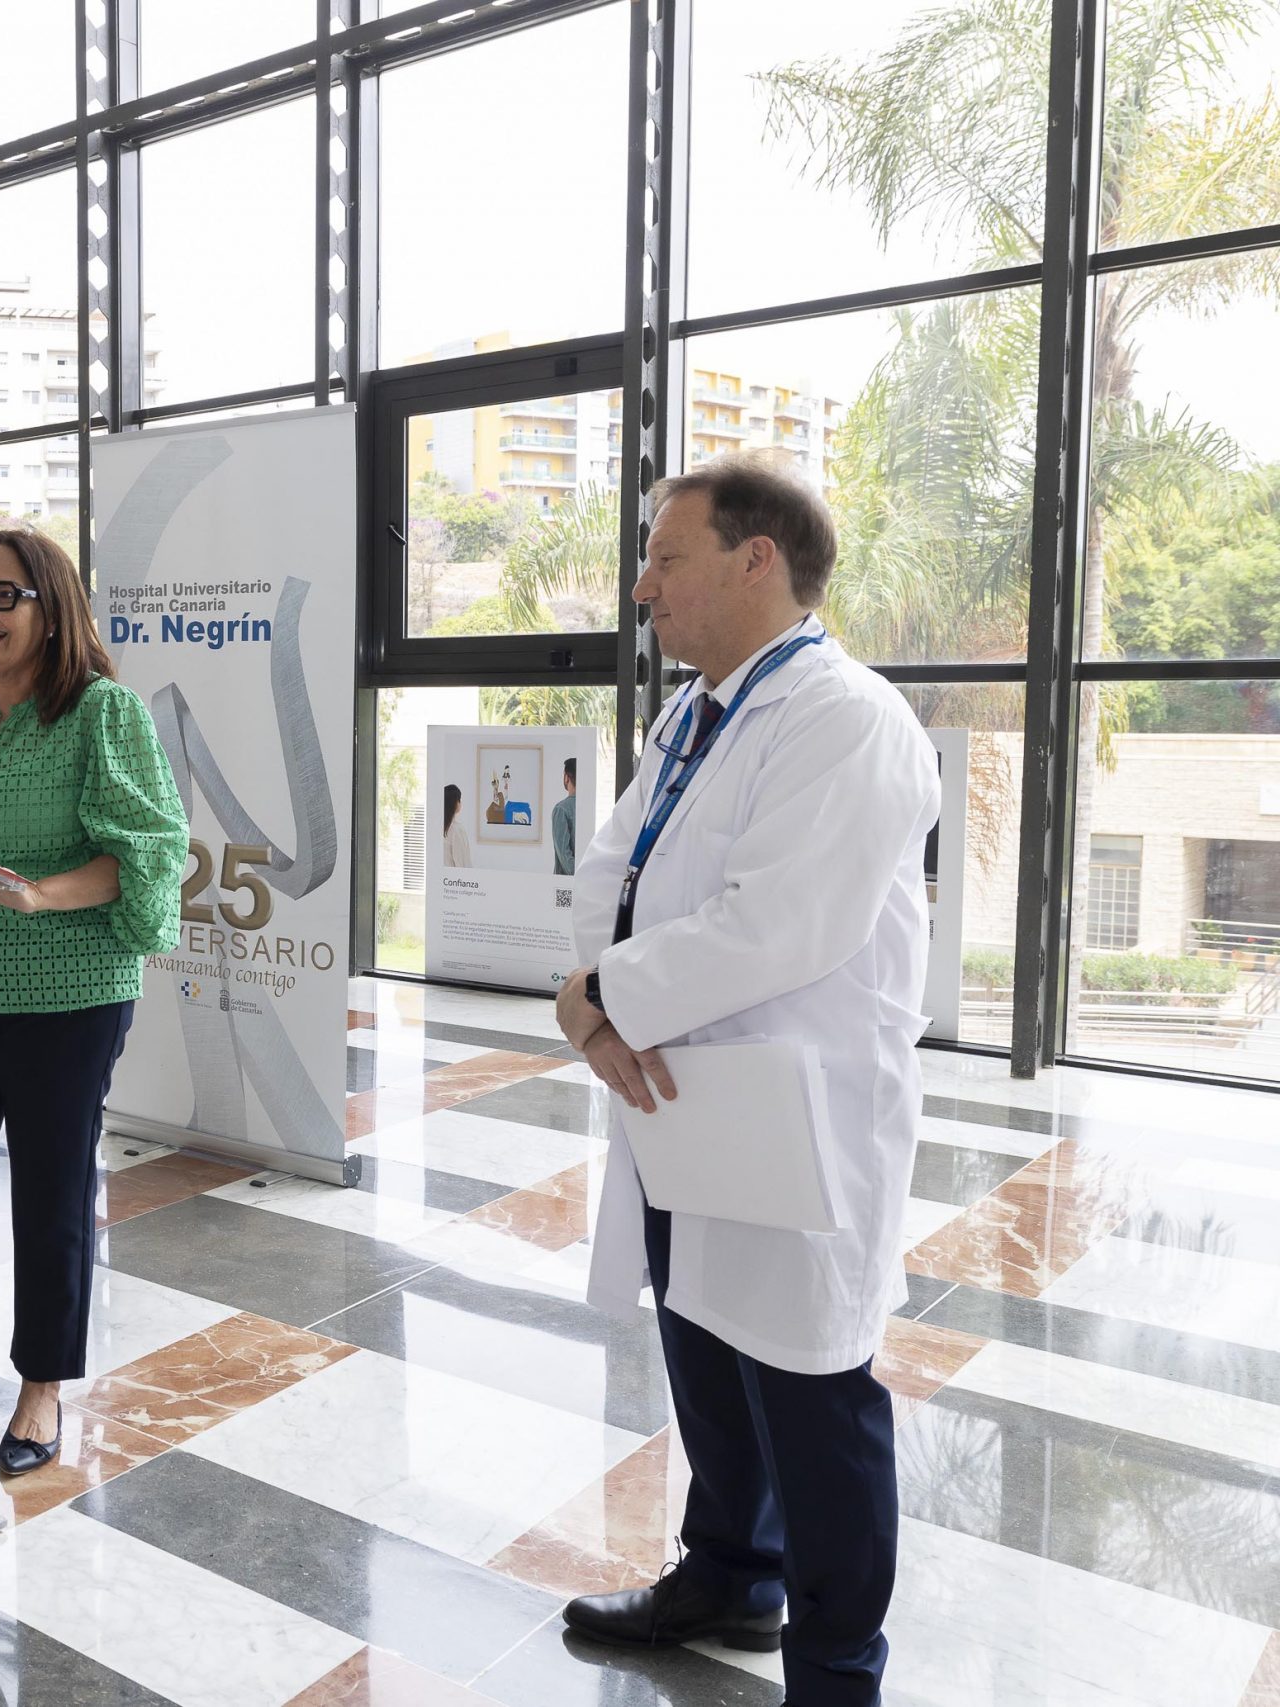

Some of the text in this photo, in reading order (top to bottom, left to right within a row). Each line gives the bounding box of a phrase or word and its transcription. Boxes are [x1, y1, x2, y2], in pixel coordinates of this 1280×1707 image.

[109, 579, 272, 600] Hospital Universitario
[109, 598, 226, 614] de Gran Canaria
[110, 612, 271, 650] Dr. Negrín
[180, 838, 274, 930] 25
[442, 877, 479, 889] Confianza
[144, 953, 296, 998] Avanzando contigo
[230, 998, 257, 1008] Gobierno
[238, 1005, 263, 1015] Canarias
